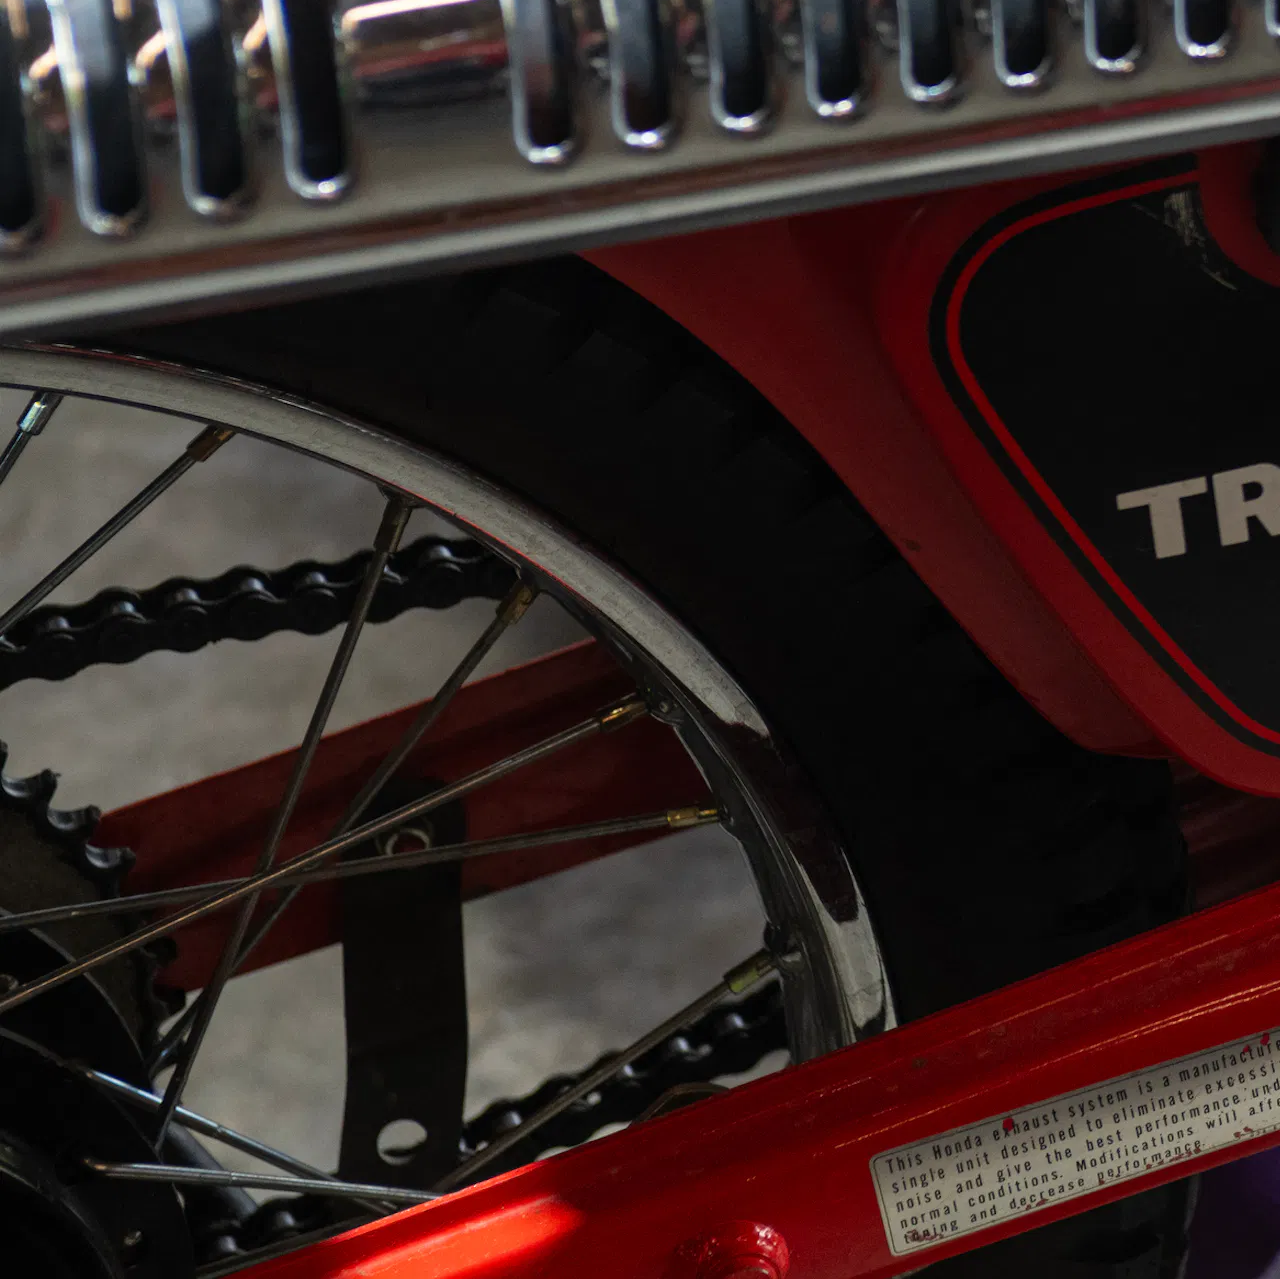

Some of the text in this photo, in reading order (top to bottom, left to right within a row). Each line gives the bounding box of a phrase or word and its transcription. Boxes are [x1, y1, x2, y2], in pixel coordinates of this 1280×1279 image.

[884, 1153, 923, 1175] This
[931, 1135, 983, 1161] Honda
[1067, 1088, 1128, 1118] system
[1137, 1080, 1153, 1096] is
[1162, 1075, 1170, 1088] a
[891, 1167, 946, 1195] single
[955, 1151, 991, 1175] unit
[1000, 1123, 1076, 1160] designed
[1085, 1118, 1103, 1133] to
[1112, 1089, 1195, 1125] eliminate
[895, 1188, 942, 1214] noise
[955, 1173, 984, 1195] and
[996, 1160, 1032, 1184] give
[1044, 1147, 1073, 1165] the
[1085, 1129, 1123, 1152] best
[1134, 1094, 1241, 1139] performance
[899, 1199, 958, 1230] normal
[967, 1170, 1064, 1208] conditions.
[1075, 1126, 1195, 1173] Modifications
[1204, 1109, 1238, 1130] will
[969, 1203, 998, 1224] and
[1008, 1177, 1085, 1210] decrease
